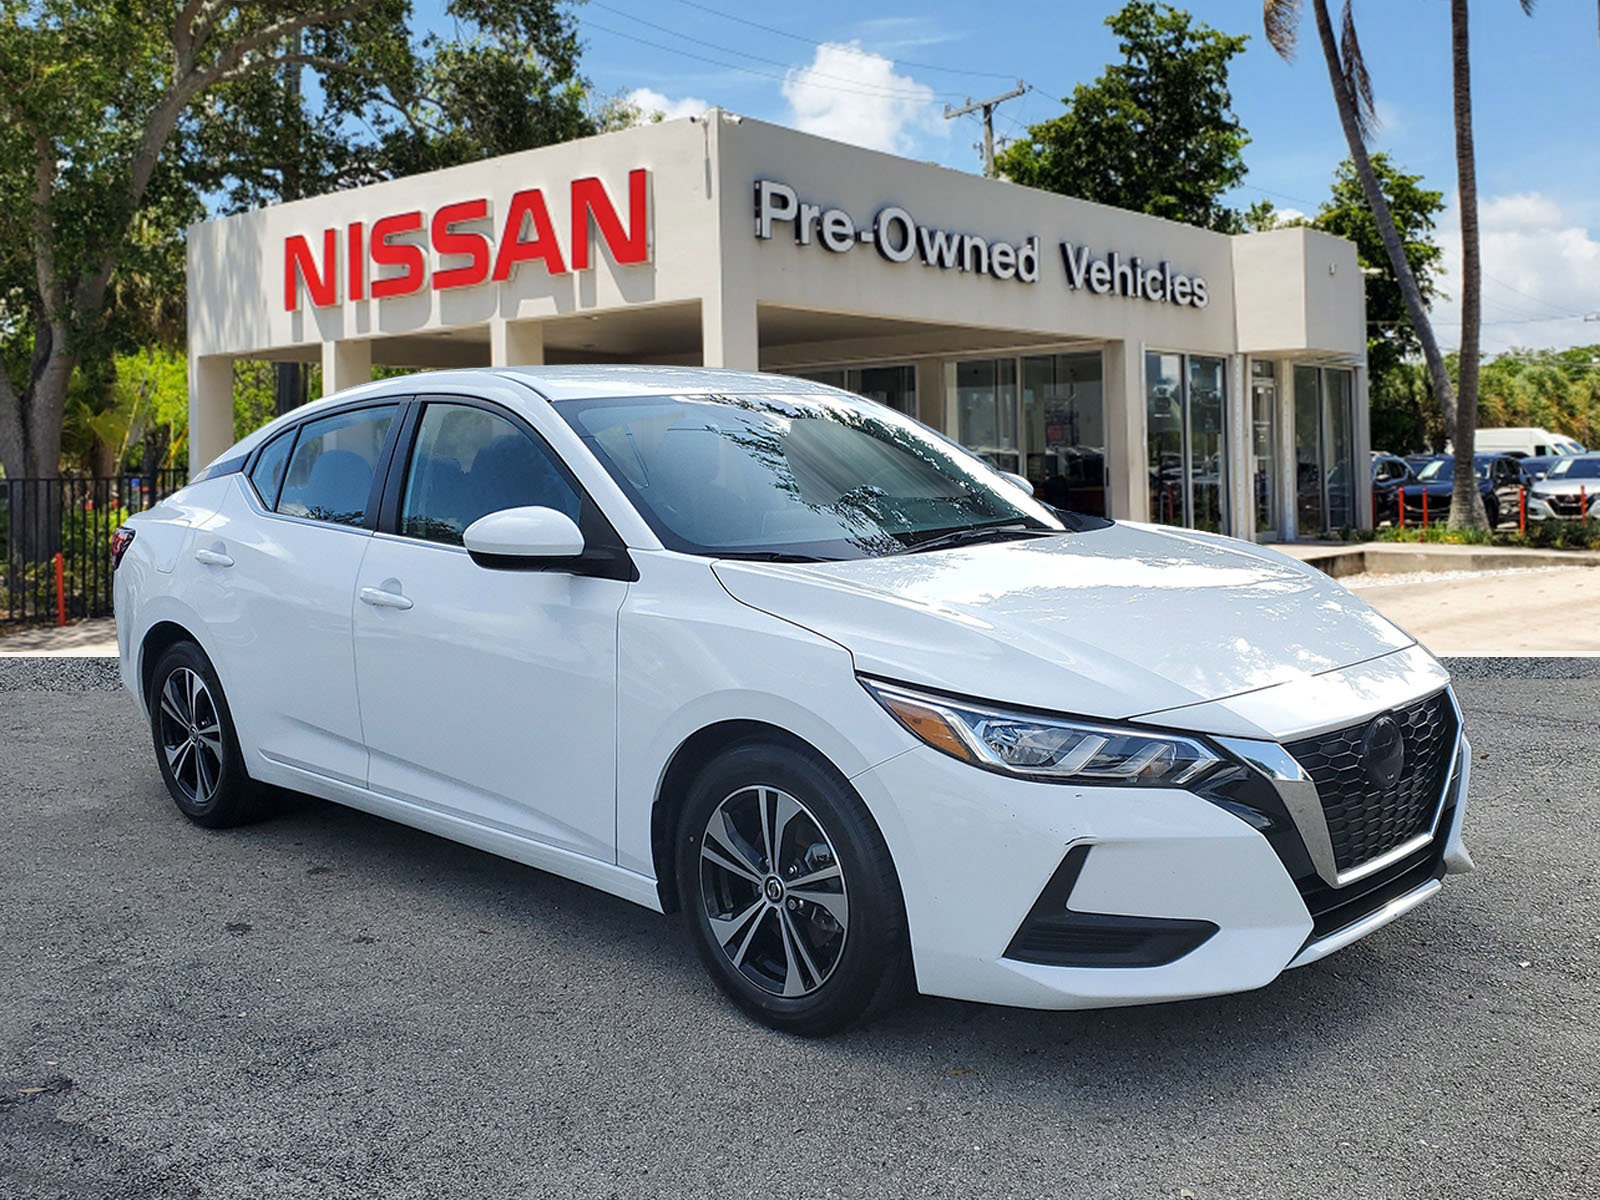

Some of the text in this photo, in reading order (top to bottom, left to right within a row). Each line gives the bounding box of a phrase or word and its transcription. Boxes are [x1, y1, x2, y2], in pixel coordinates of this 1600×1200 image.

[284, 169, 648, 311] NISSAN
[755, 179, 1209, 308] Pre-Owned Vehicles
